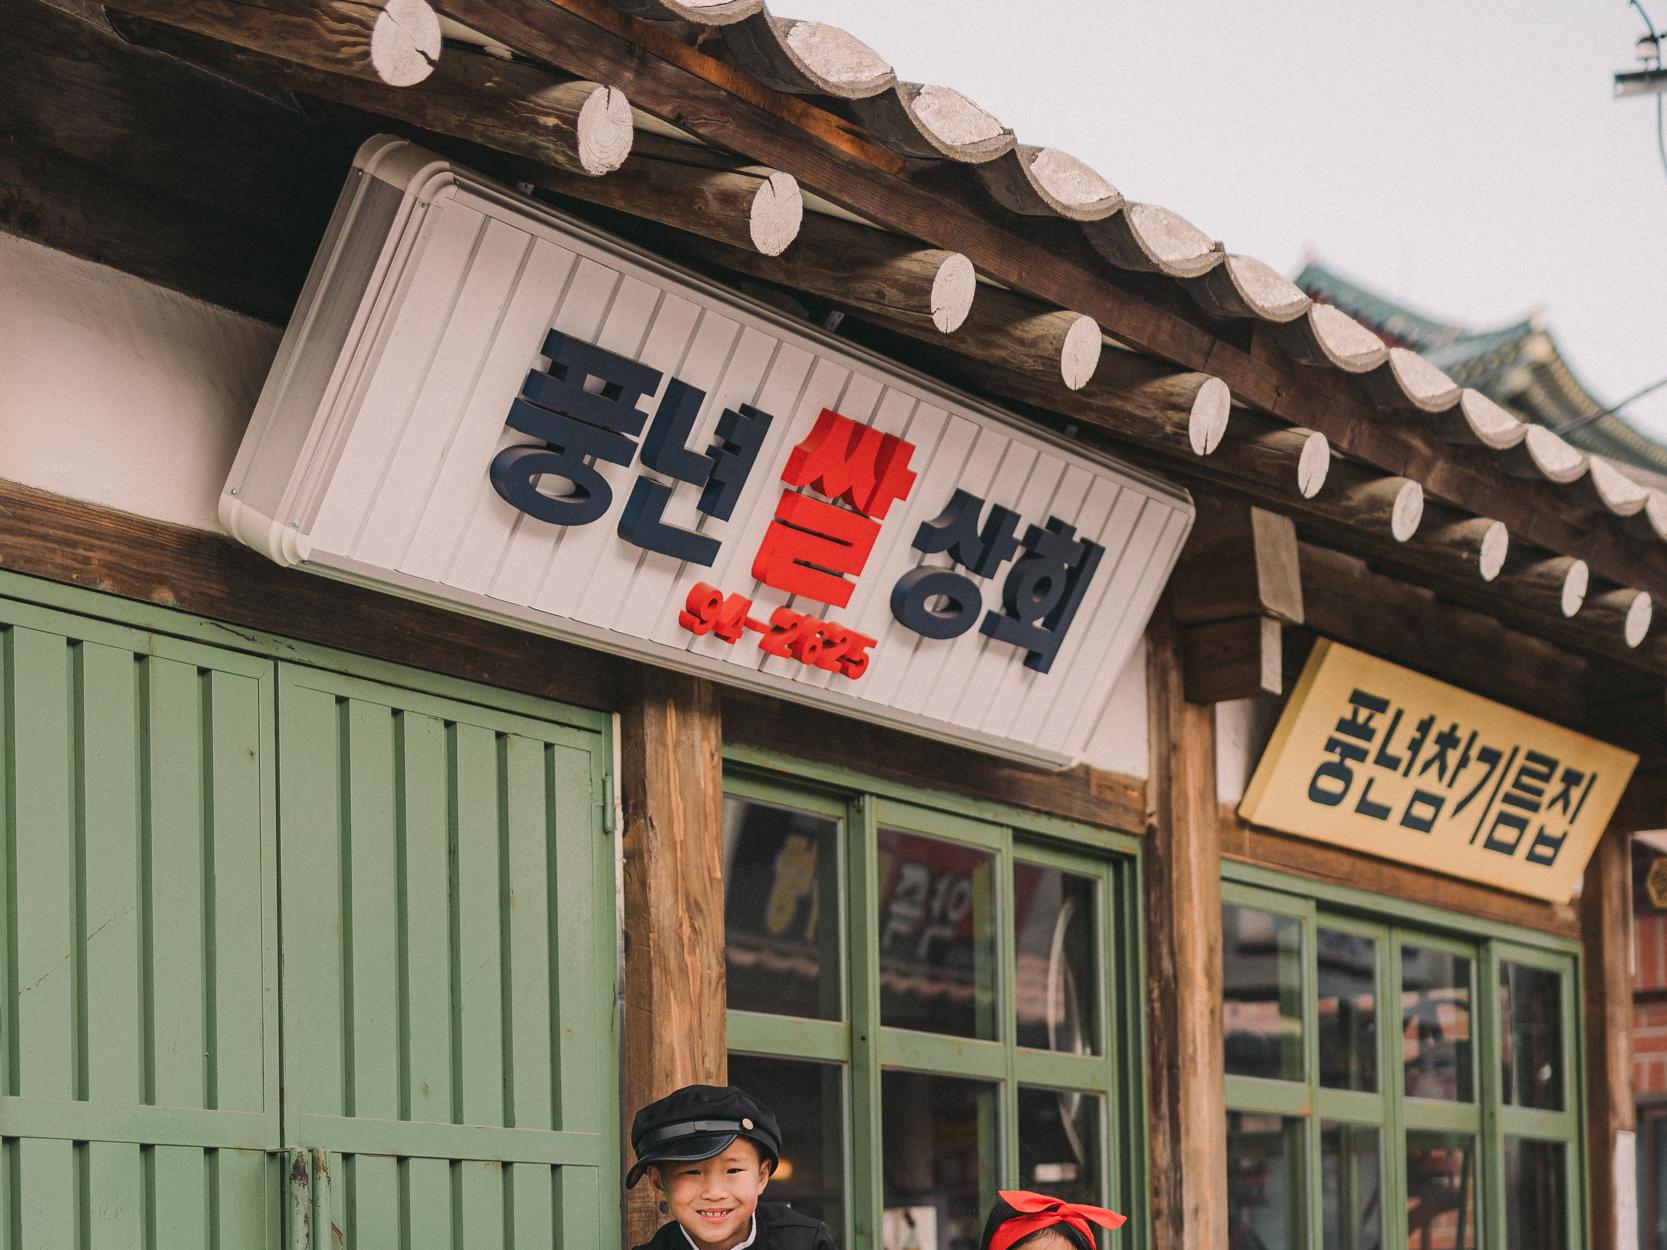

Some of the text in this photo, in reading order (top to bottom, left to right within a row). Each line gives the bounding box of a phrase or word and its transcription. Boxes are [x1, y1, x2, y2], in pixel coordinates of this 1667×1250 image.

[489, 328, 1106, 675] 풍년 쌀 상회
[678, 581, 878, 680] 94-2625
[1307, 688, 1598, 867] 풍년참기름집
